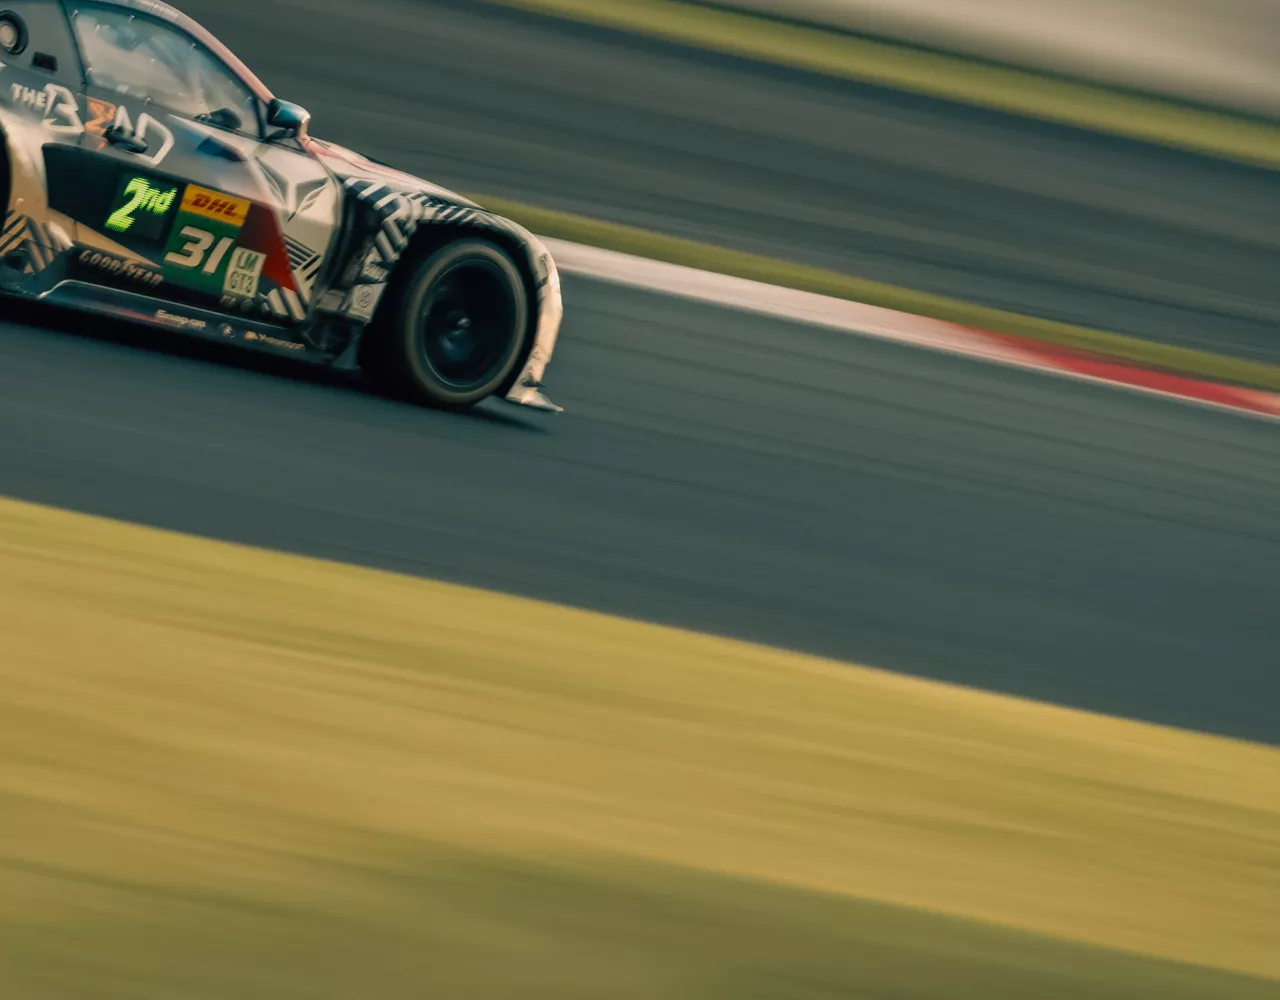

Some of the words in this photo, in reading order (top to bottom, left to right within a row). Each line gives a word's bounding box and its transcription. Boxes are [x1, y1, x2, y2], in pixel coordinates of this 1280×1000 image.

[10, 82, 48, 109] THE
[104, 176, 178, 233] 2nd
[190, 192, 240, 218] DHL
[163, 225, 236, 277] 31
[235, 250, 260, 273] LM
[78, 249, 165, 288] GOODYEAR
